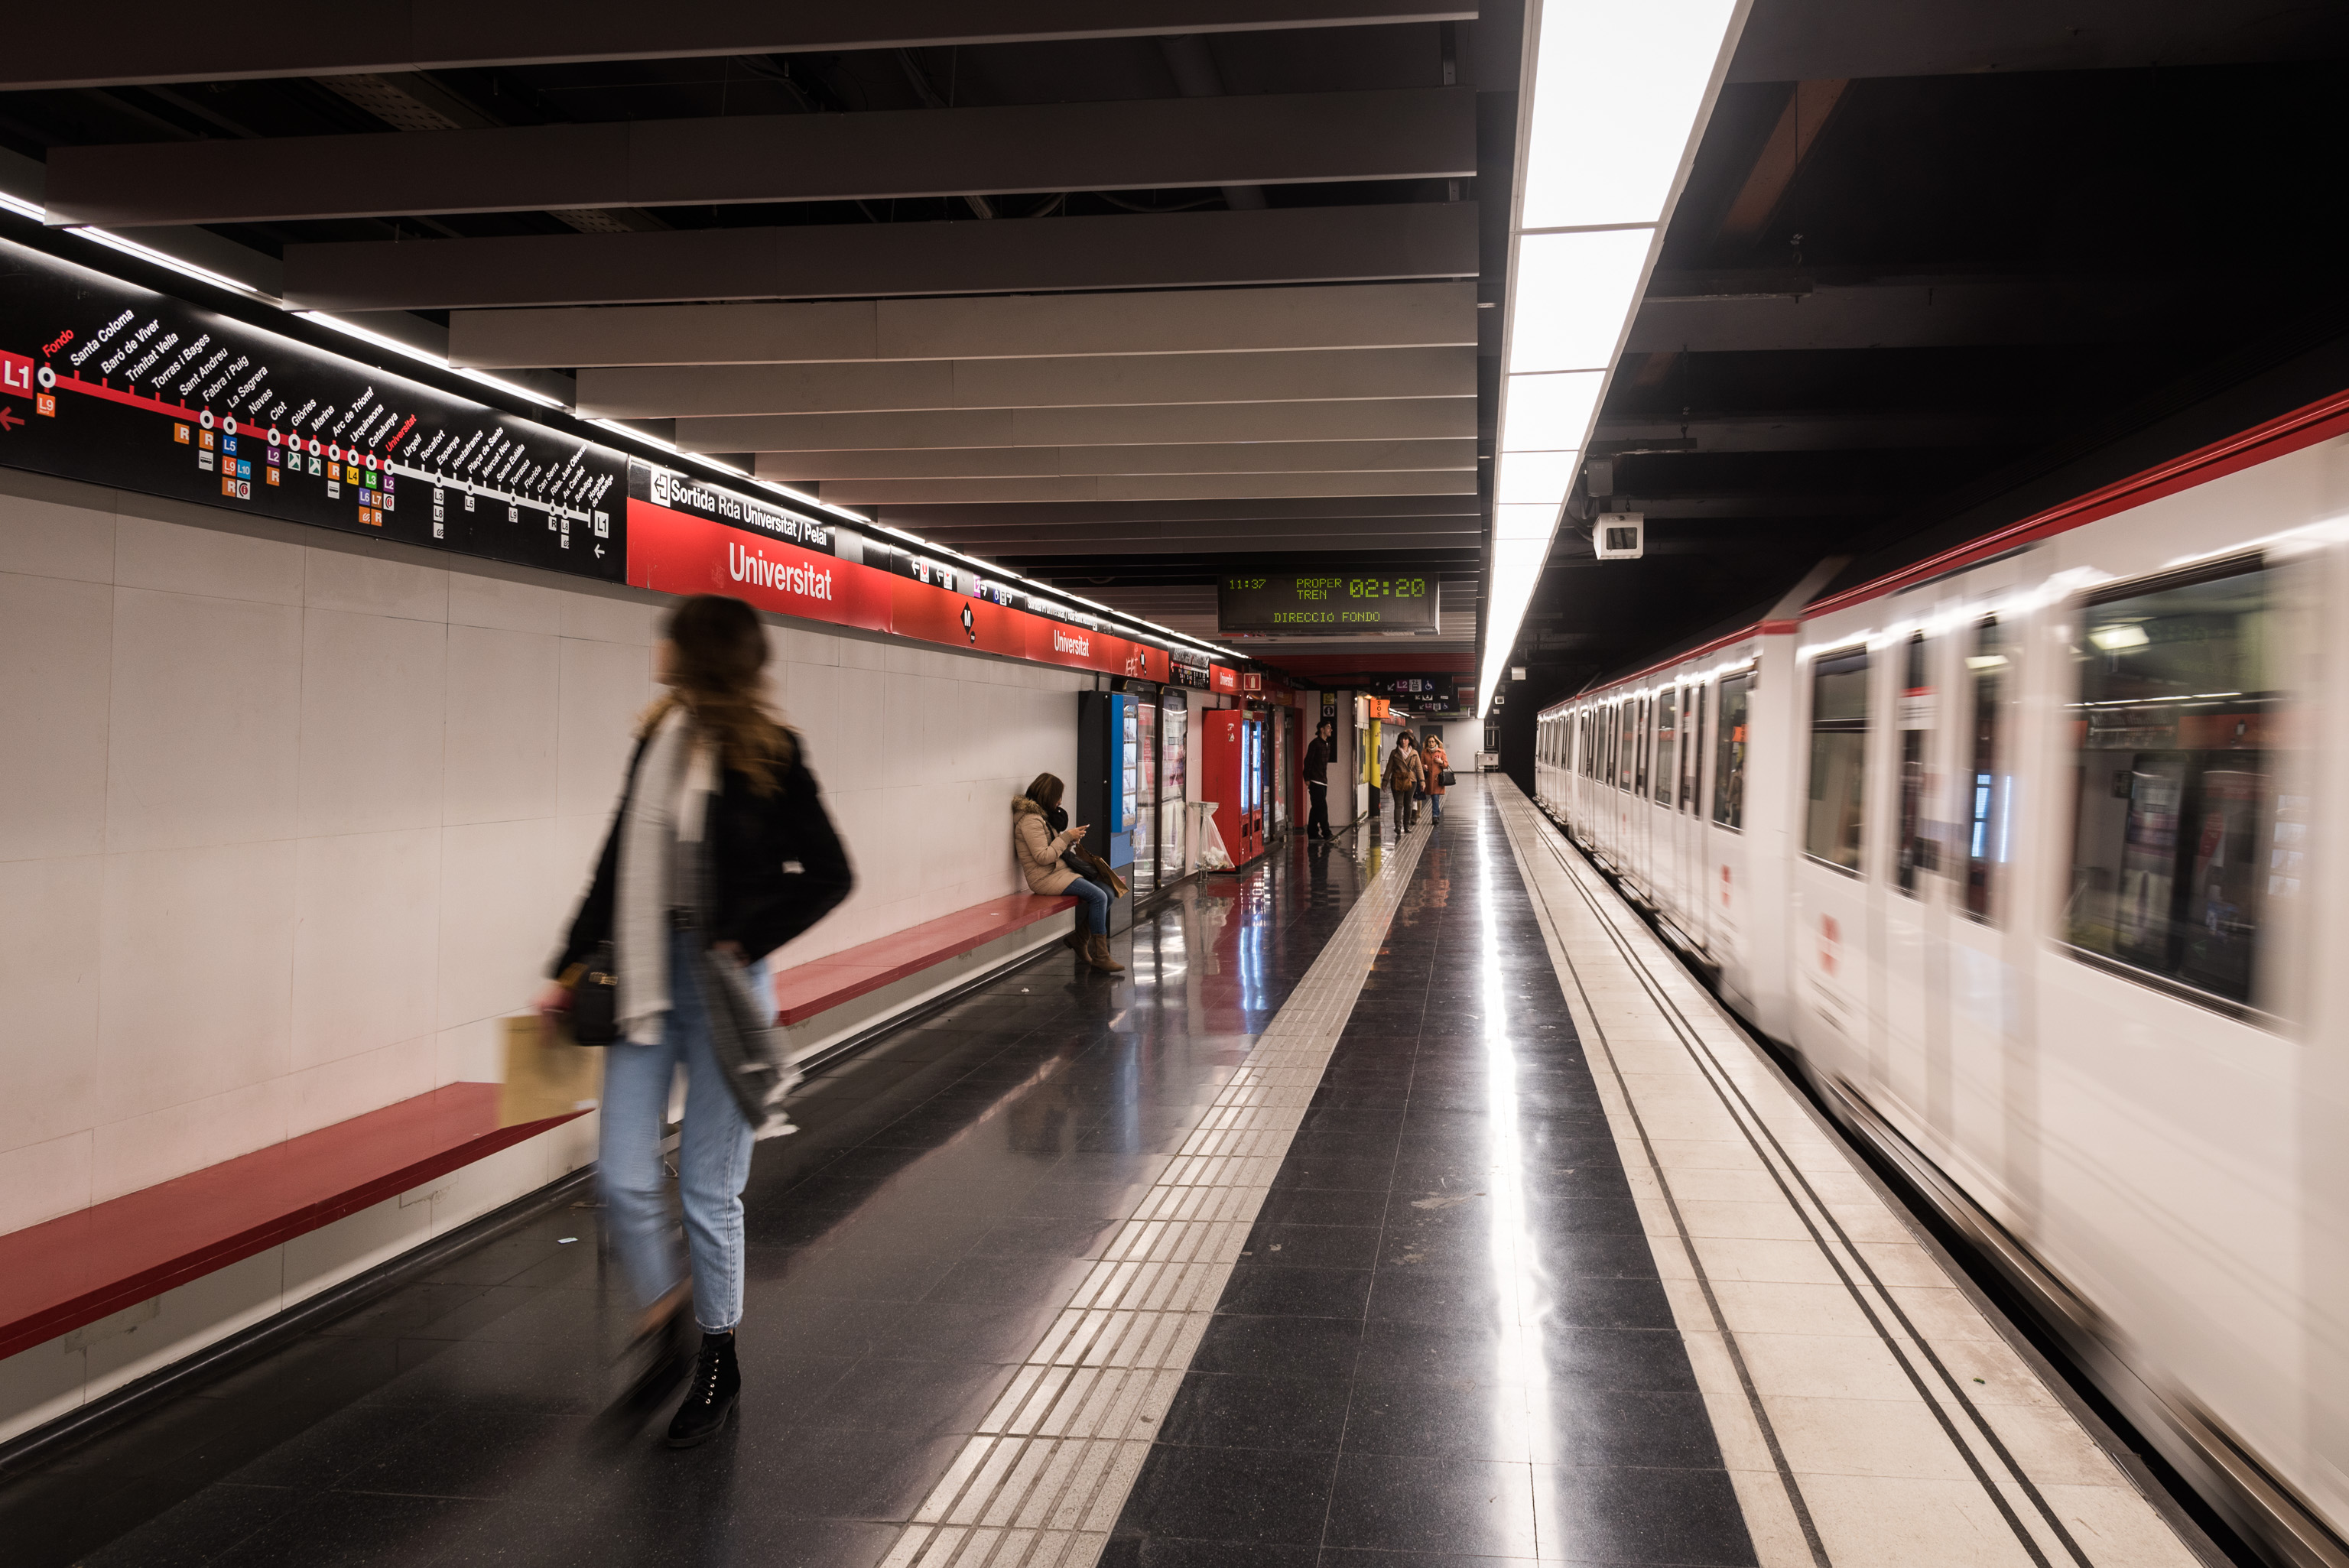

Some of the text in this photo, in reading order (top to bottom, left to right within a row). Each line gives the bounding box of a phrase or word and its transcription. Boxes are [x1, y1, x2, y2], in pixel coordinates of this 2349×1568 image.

[42, 330, 74, 358] Fondo
[70, 310, 135, 366] Santa Coloma
[100, 319, 160, 375] Baró de Viver
[125, 333, 179, 381] Trinitat Vella
[151, 333, 210, 389] Torras i Bages
[4, 360, 29, 389] L1
[179, 348, 229, 396] Sant Andreu
[202, 355, 249, 402] Fabra i Puig
[227, 366, 268, 408] La Sagrera
[39, 398, 54, 411] L9
[249, 388, 273, 414] Navas
[270, 401, 288, 420] Clot
[291, 398, 317, 427] Glòries
[310, 405, 335, 431] Marina
[332, 386, 375, 437] Arc de Triomf
[350, 404, 384, 443] Urquinaona
[368, 412, 398, 447] Catalunya
[180, 427, 189, 440] R
[205, 433, 213, 446] R
[385, 414, 417, 453] Universitat
[224, 439, 236, 452] L5
[403, 433, 422, 457] Urgell
[420, 429, 446, 462] Rocafort
[436, 435, 460, 466] Espanya
[452, 430, 483, 470] Hostafrancs
[467, 427, 504, 474] Plaça de Sants
[268, 450, 280, 463] L2
[482, 440, 511, 478] Mercat Nou
[224, 461, 236, 472] L9
[238, 466, 250, 477] L10
[271, 470, 280, 482] R
[332, 465, 340, 476] R
[349, 470, 357, 481] L4
[496, 463, 512, 482] Santa
[509, 459, 531, 486] Torrassa
[562, 464, 573, 481] Just
[227, 480, 236, 493] R
[366, 475, 376, 485] L3
[384, 479, 394, 489] L2
[524, 465, 542, 489] Florida
[537, 462, 560, 493] Can Serra
[434, 492, 443, 501] L3
[575, 476, 593, 503] Bellvitge
[587, 473, 606, 501] Hospital
[360, 492, 370, 502] L6
[372, 495, 382, 505] L7
[466, 499, 474, 508] L5
[592, 498, 599, 508] de
[375, 511, 382, 523] R
[434, 508, 443, 518] L8
[510, 511, 517, 519] L9
[671, 479, 827, 546] Sortida Rda Universitat / Pelai
[551, 519, 557, 528] R
[562, 522, 569, 531] L8
[597, 517, 606, 532] L1
[729, 542, 832, 601] Universitat
[1230, 579, 1266, 589] 11:37
[1296, 578, 1342, 589] PROPER
[1350, 578, 1425, 598] 02:20
[1296, 590, 1327, 599] TREN
[1342, 612, 1380, 622] FONDO
[1054, 629, 1089, 657] Universitat
